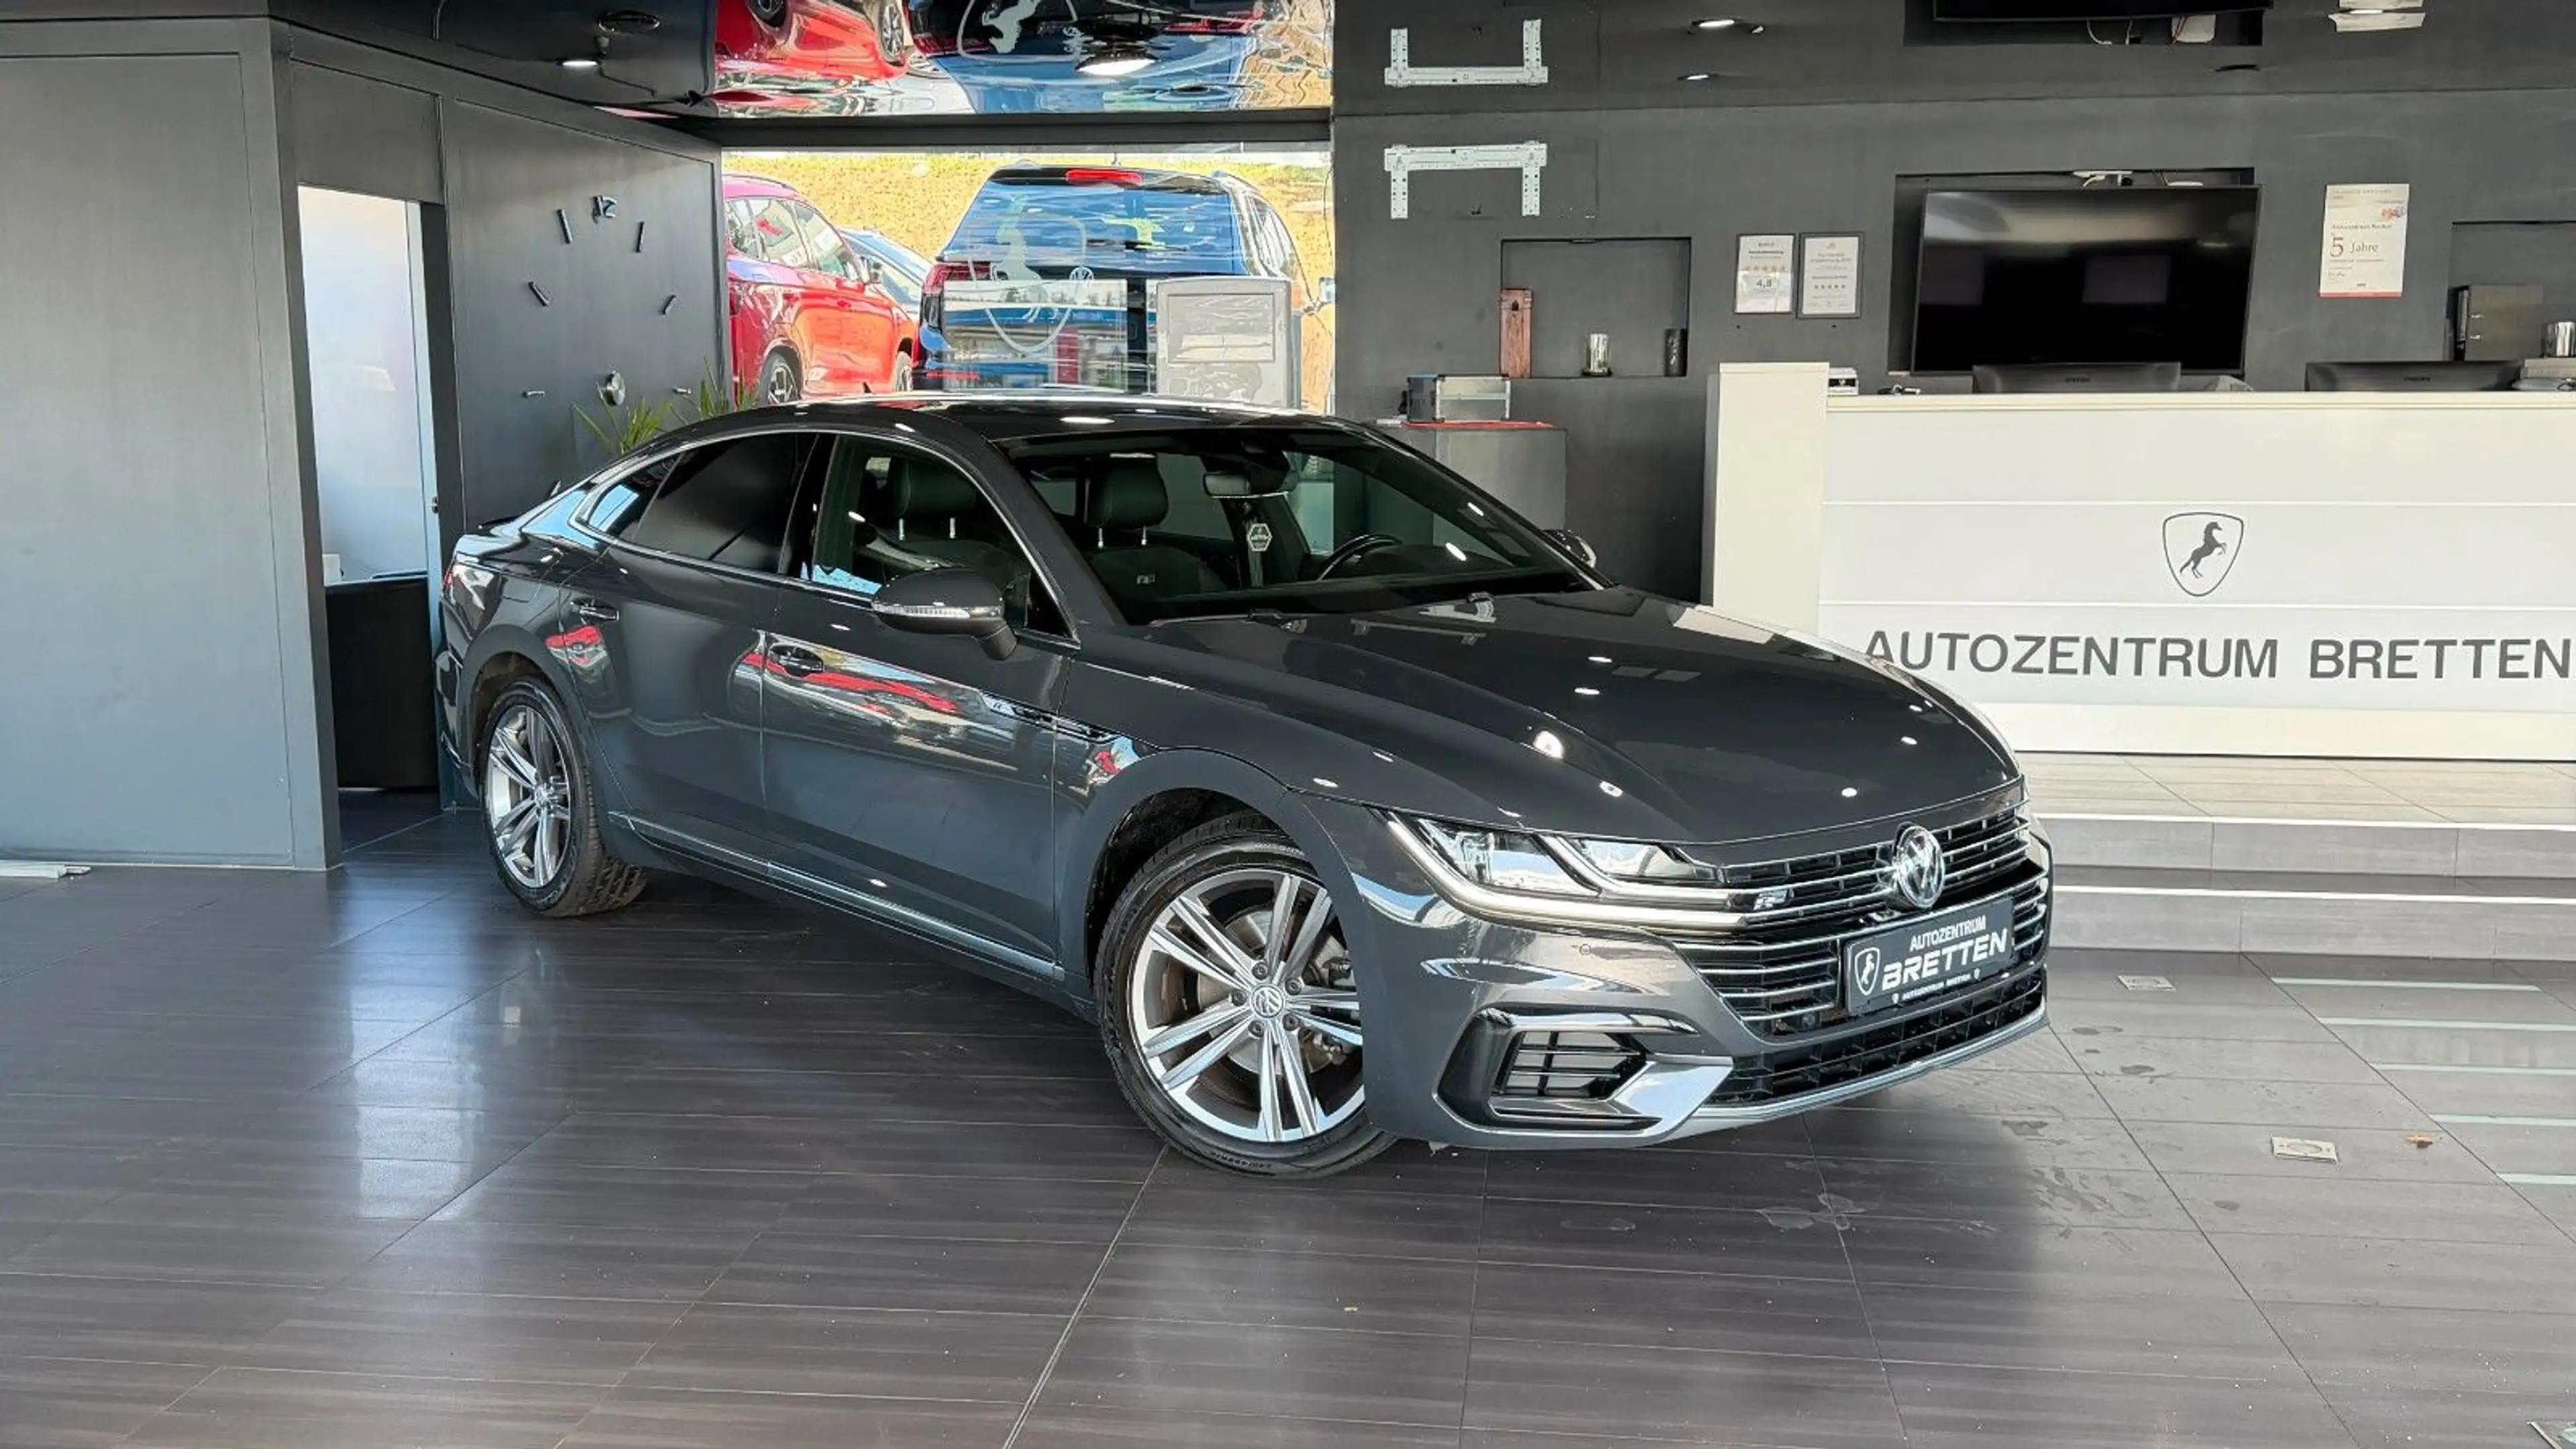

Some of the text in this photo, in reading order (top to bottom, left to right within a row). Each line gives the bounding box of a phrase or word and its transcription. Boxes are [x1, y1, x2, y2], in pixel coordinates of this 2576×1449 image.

[2330, 237, 2379, 258] 5 Jahre
[1866, 631, 2571, 679] AUTOZENTRUM BRETTEN
[1909, 915, 1986, 952] AUTOZENTRUM
[1882, 927, 2008, 991] BRETTEN
